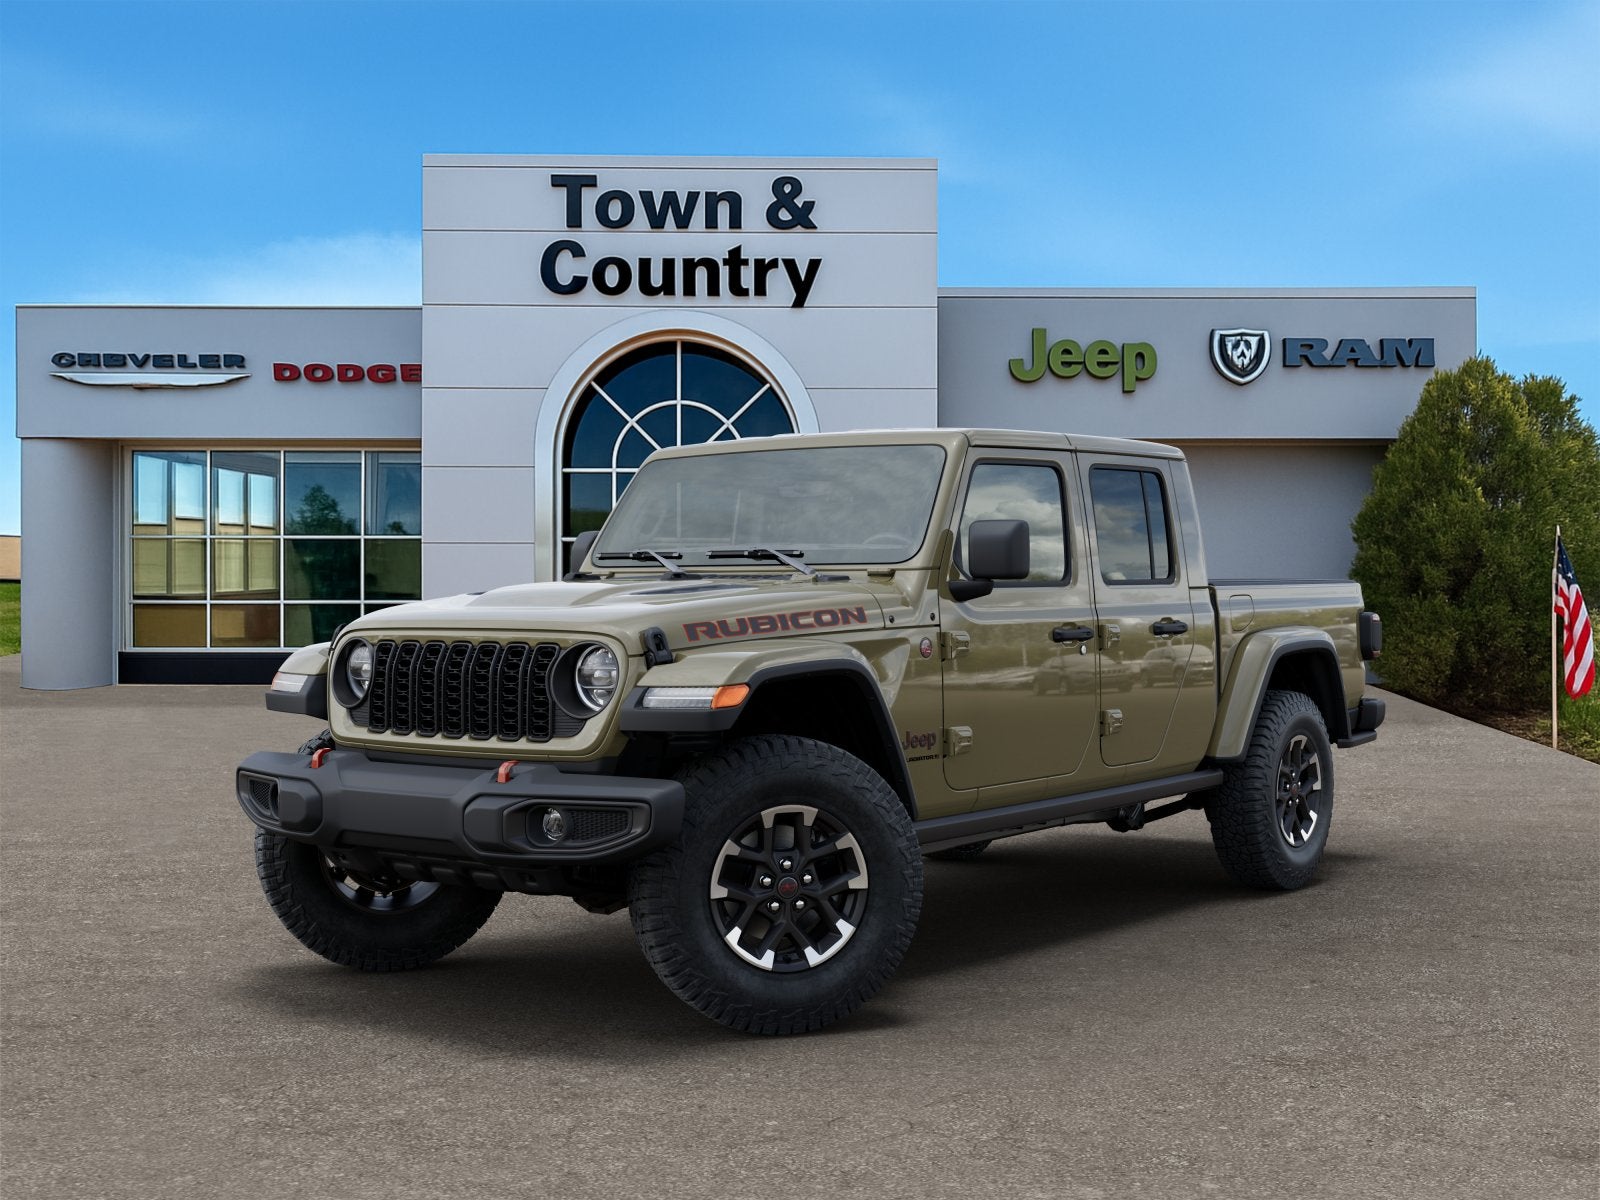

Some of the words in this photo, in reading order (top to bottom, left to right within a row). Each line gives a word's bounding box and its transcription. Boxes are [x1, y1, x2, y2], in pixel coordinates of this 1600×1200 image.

[550, 174, 743, 230] Town
[765, 175, 818, 230] &
[539, 239, 822, 308] Country
[1008, 327, 1157, 393] Jeep
[1282, 337, 1436, 368] RAM
[273, 363, 422, 382] DODGE
[682, 606, 868, 642] RUBICON
[902, 730, 936, 750] Jeep
